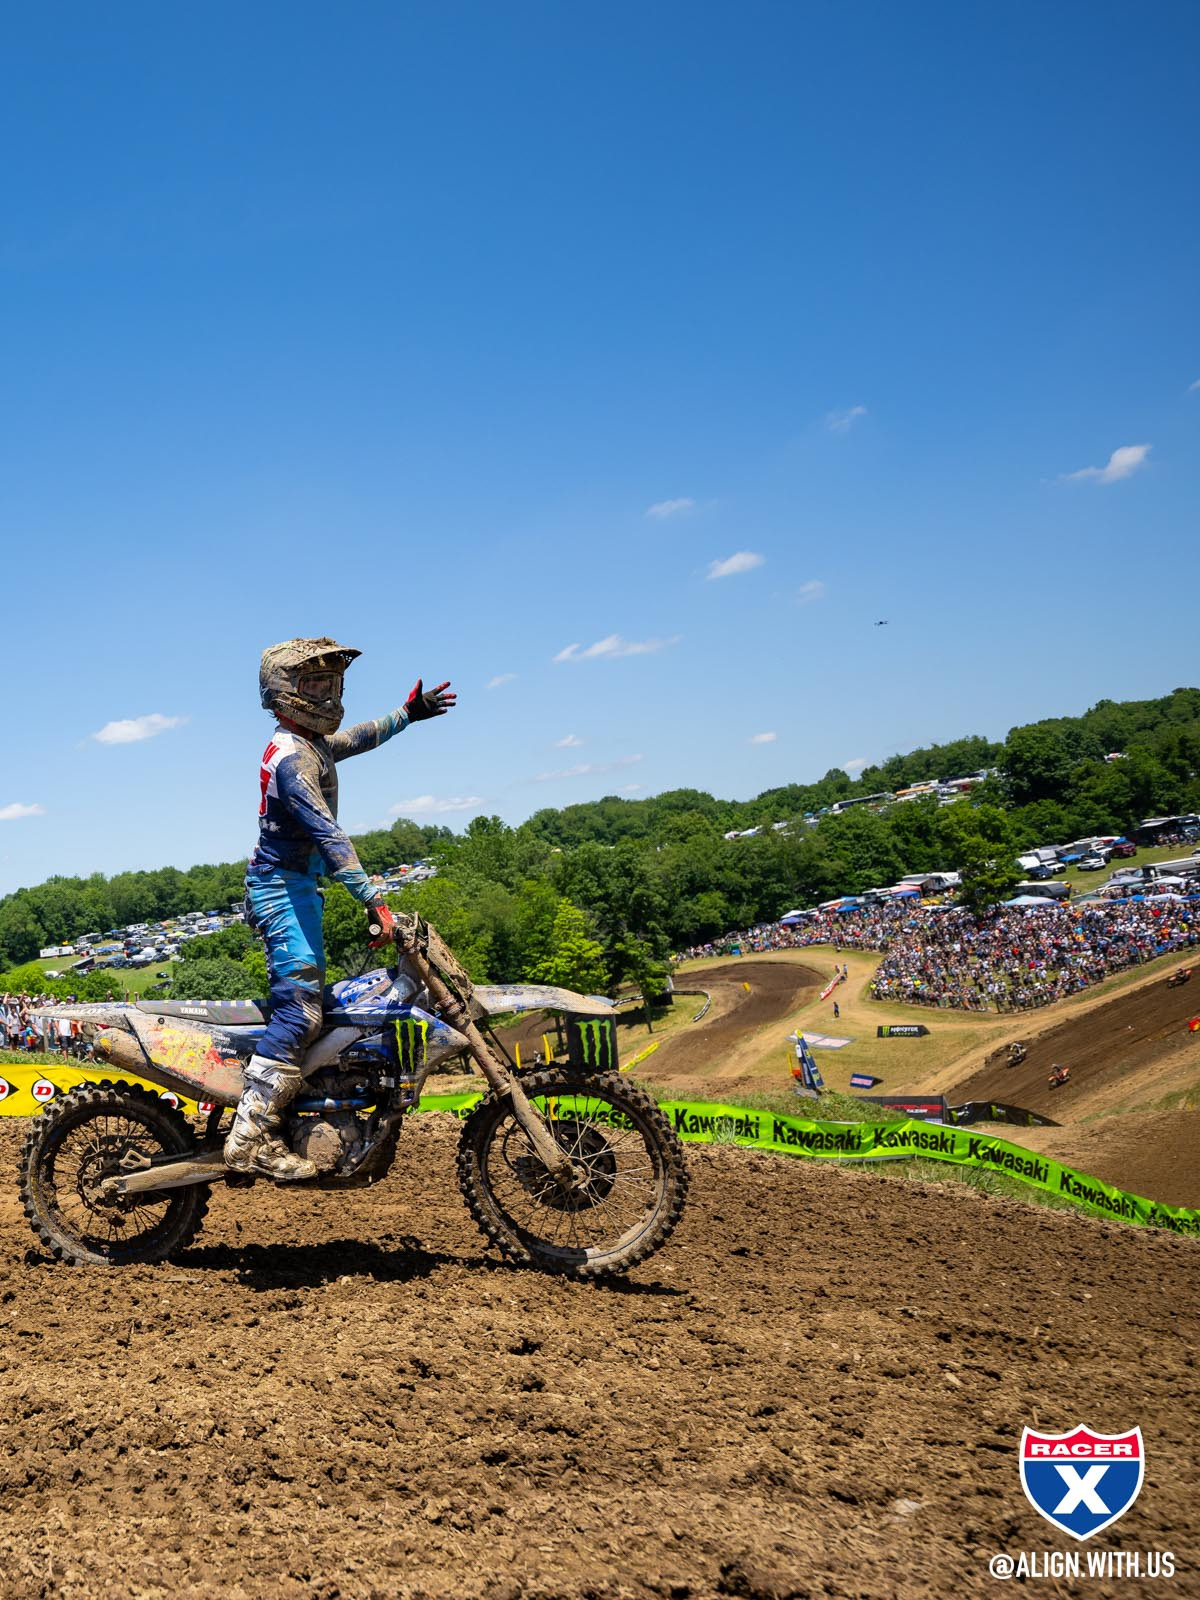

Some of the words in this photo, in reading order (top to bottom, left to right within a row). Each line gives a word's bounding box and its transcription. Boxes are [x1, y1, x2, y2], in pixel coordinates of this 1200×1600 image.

[180, 1007, 208, 1016] YAMAHA
[35, 1086, 51, 1096] D
[773, 1120, 862, 1151] Kawasaki
[874, 1127, 956, 1155] Kawasaki
[968, 1138, 1049, 1183] Kawasaki
[1059, 1170, 1136, 1219] Kawasaki
